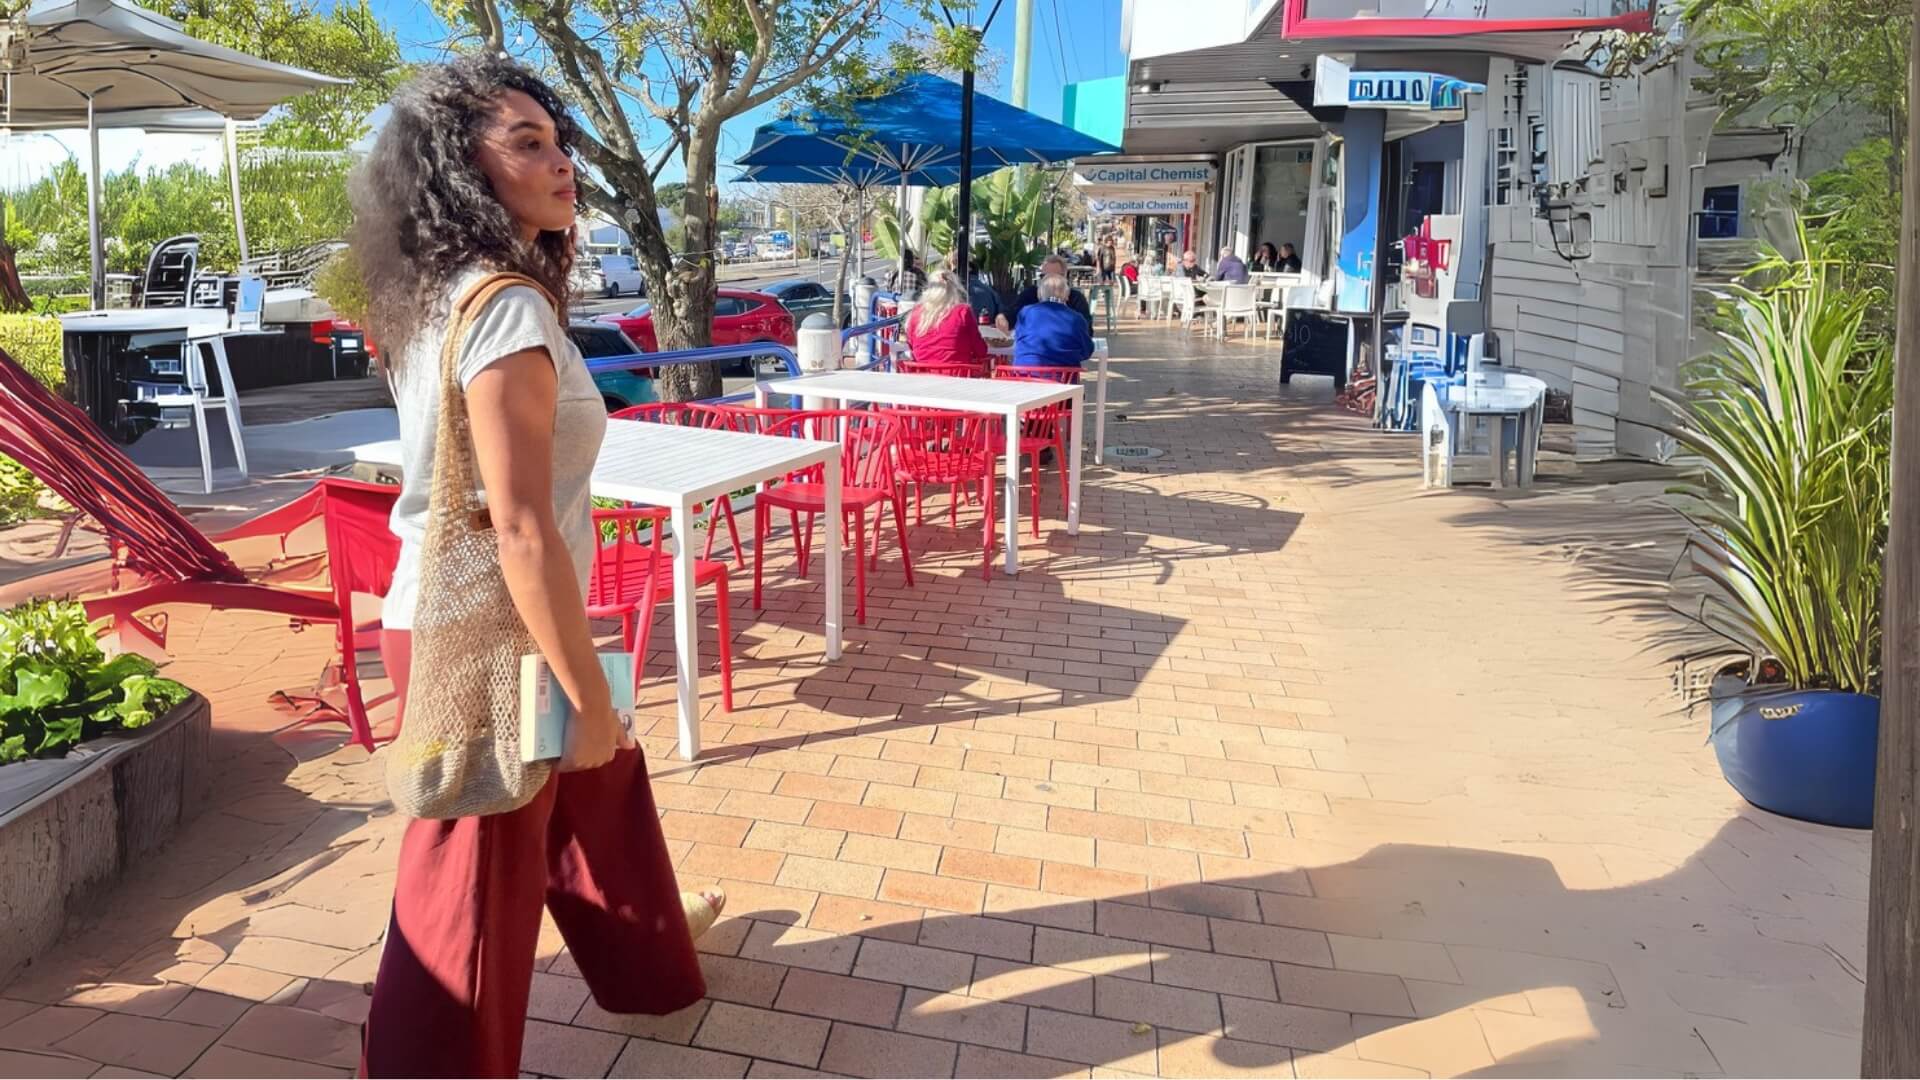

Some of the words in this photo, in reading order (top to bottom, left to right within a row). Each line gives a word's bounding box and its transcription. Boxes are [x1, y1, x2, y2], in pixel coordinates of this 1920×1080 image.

[1097, 168, 1147, 182] Capital
[1150, 167, 1209, 180] Chemist
[1108, 200, 1144, 211] Capital
[1146, 200, 1188, 210] Chemist
